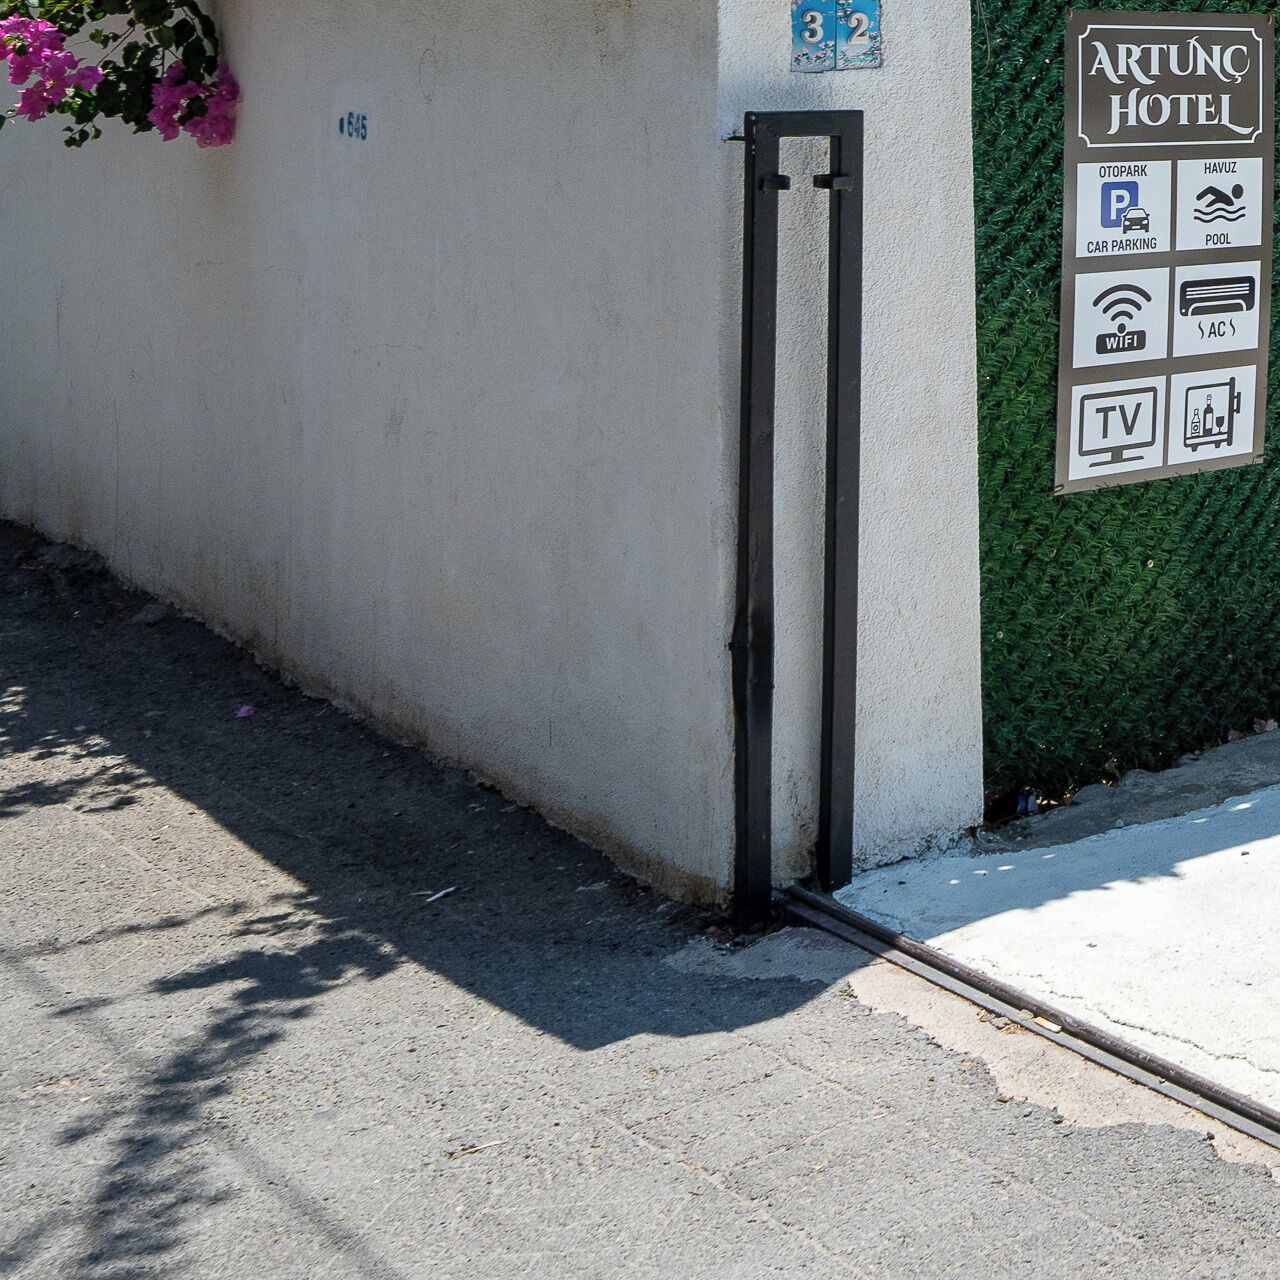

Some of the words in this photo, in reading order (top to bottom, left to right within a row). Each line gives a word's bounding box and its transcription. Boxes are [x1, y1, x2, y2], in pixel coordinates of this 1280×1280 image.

[801, 9, 869, 45] 32
[1088, 36, 1251, 85] ARTUNÇ
[1107, 87, 1255, 135] HOTEL
[1099, 164, 1148, 178] OTOPARK
[1204, 161, 1237, 174] HAVUZ
[1110, 189, 1131, 220] P
[1087, 240, 1109, 253] CAR
[1111, 237, 1157, 252] PARKING
[1205, 233, 1232, 246] POOL
[1207, 321, 1226, 339] AC
[1105, 334, 1138, 350] WIFI
[1095, 402, 1143, 439] TV
